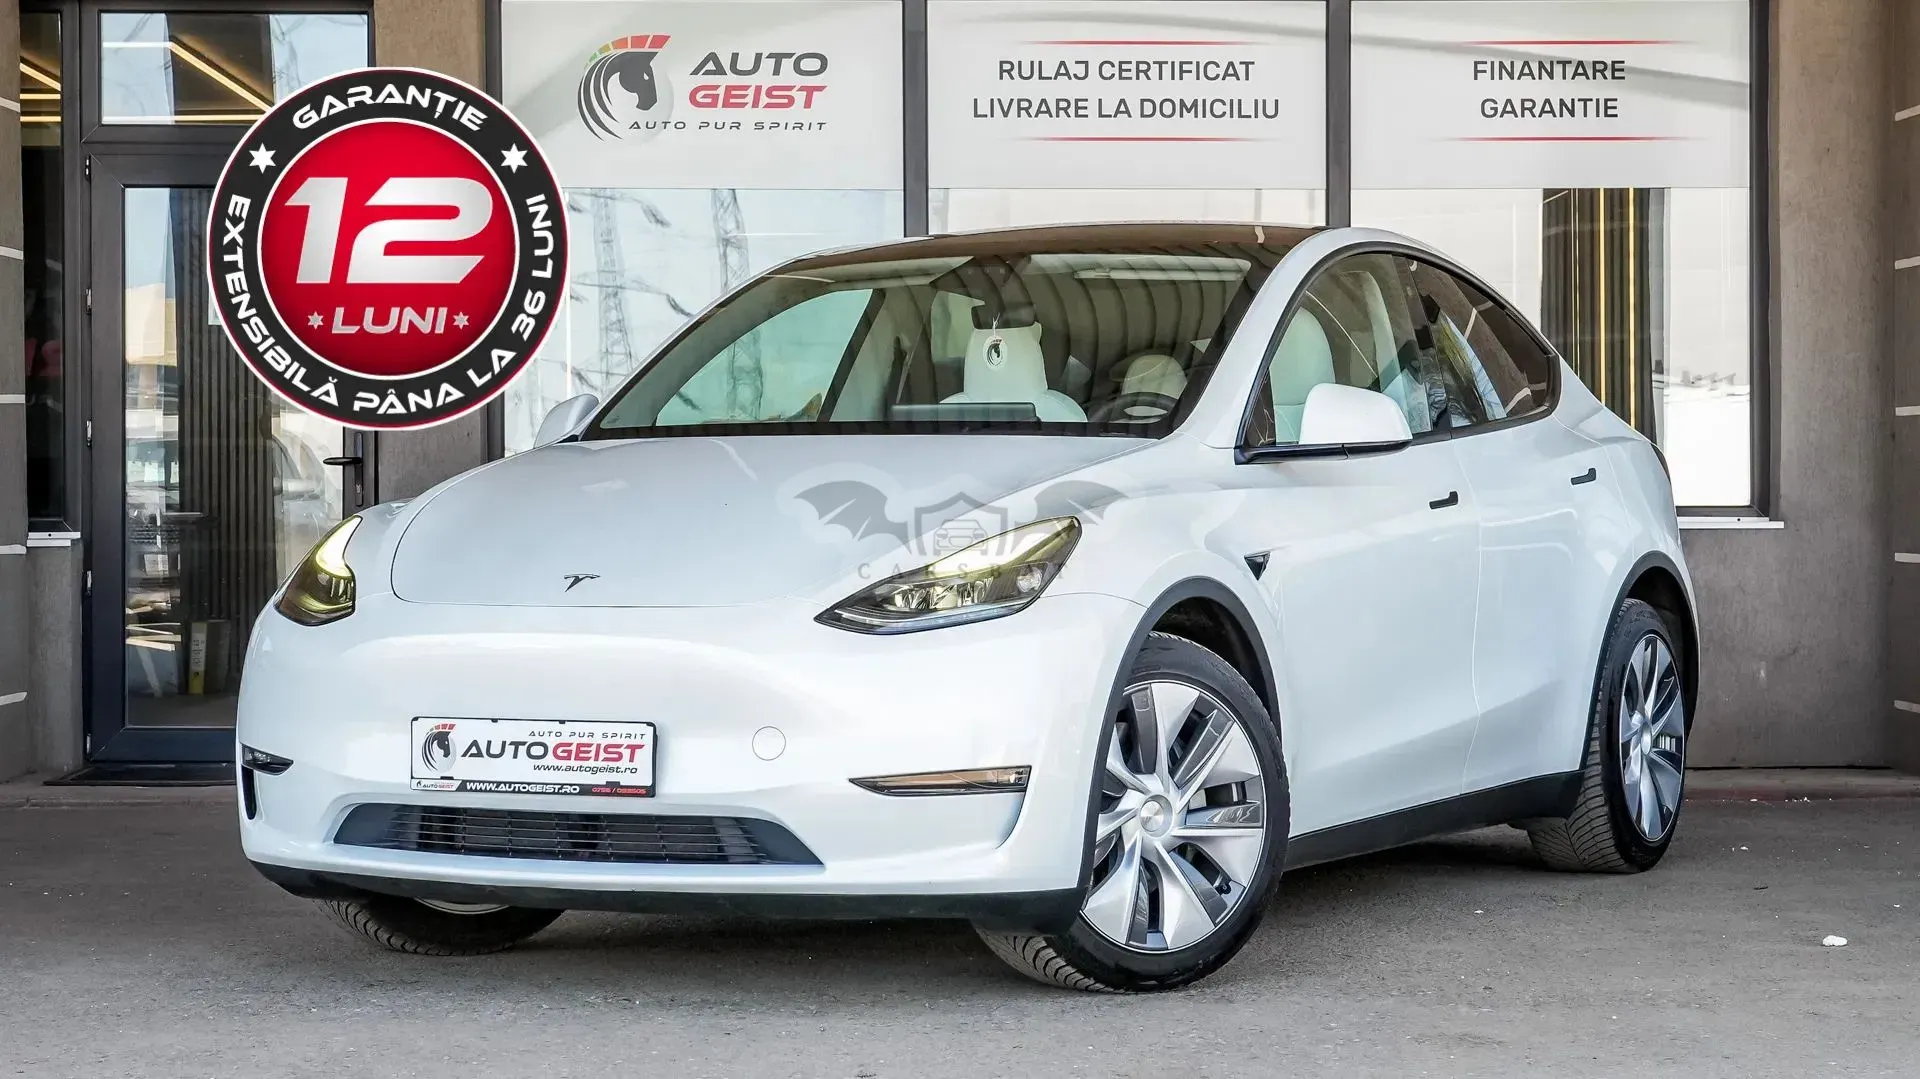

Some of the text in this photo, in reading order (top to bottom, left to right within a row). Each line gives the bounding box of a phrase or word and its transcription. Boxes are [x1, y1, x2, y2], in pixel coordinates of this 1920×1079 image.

[689, 51, 829, 77] AUTO
[998, 60, 1255, 82] RULAJ CERTIFICAT
[1472, 60, 1626, 81] FINANTARE
[688, 84, 828, 110] GEIST
[972, 97, 1280, 120] LIVRARE LA DOMICILIU
[1480, 97, 1619, 119] GARANTIE
[628, 121, 827, 131] AUTO PUR SPIRIT
[528, 730, 647, 740] AUTO PUR SPIRIT
[533, 763, 638, 775] www.autogeist.ro
[466, 781, 581, 794] WWW.AUTOGEIST.RO
